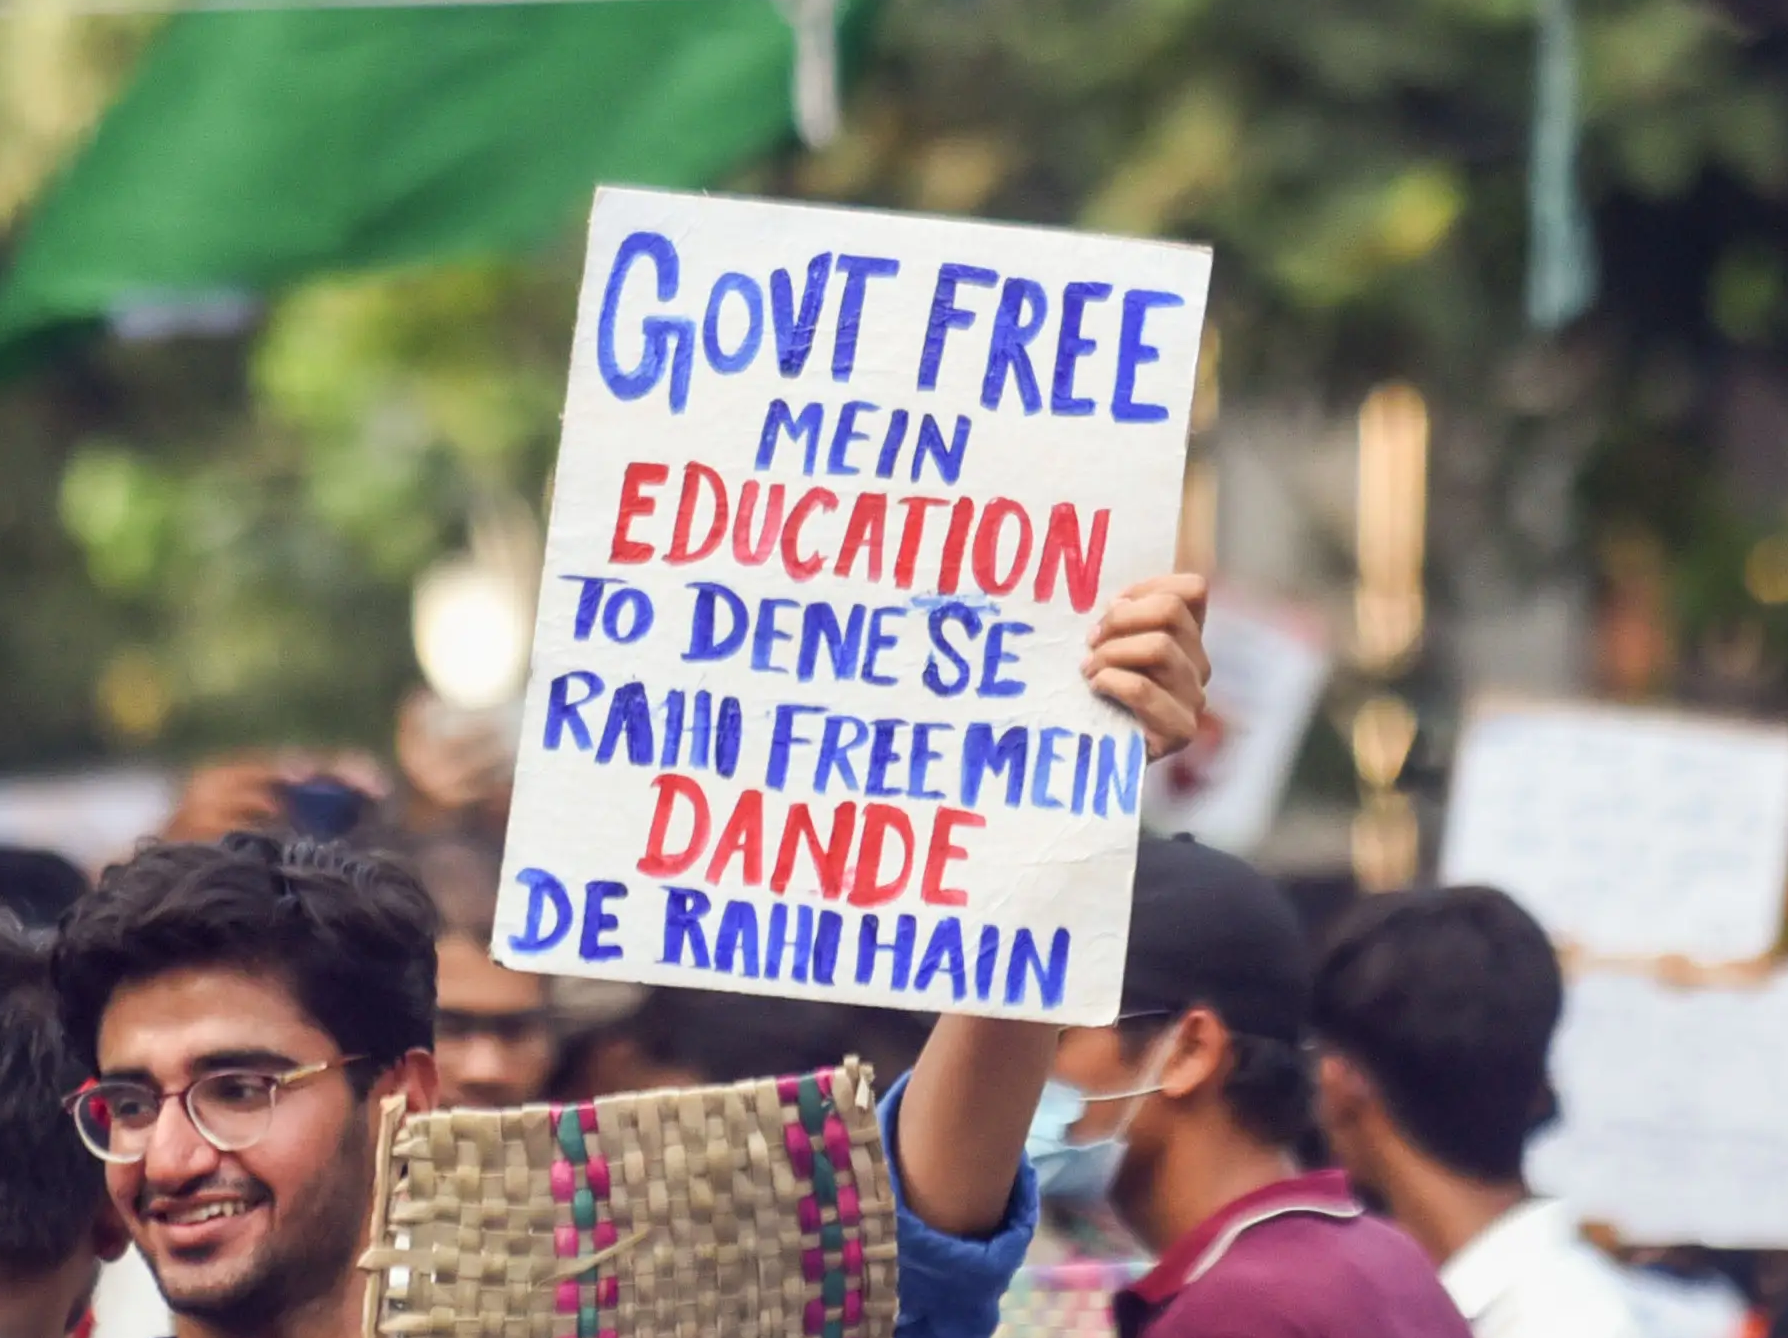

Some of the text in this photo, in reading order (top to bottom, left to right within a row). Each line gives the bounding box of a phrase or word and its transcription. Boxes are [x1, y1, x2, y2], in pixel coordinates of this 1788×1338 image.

[596, 230, 1186, 424] GOVT FREE
[754, 399, 971, 485] MEIN
[608, 460, 1110, 613] EDUCATION
[558, 574, 655, 644] TO
[681, 580, 909, 686] DENE
[543, 670, 743, 778] RAHI
[636, 772, 988, 908] DANDE
[507, 866, 1071, 1010] DE RAHI HAIN
